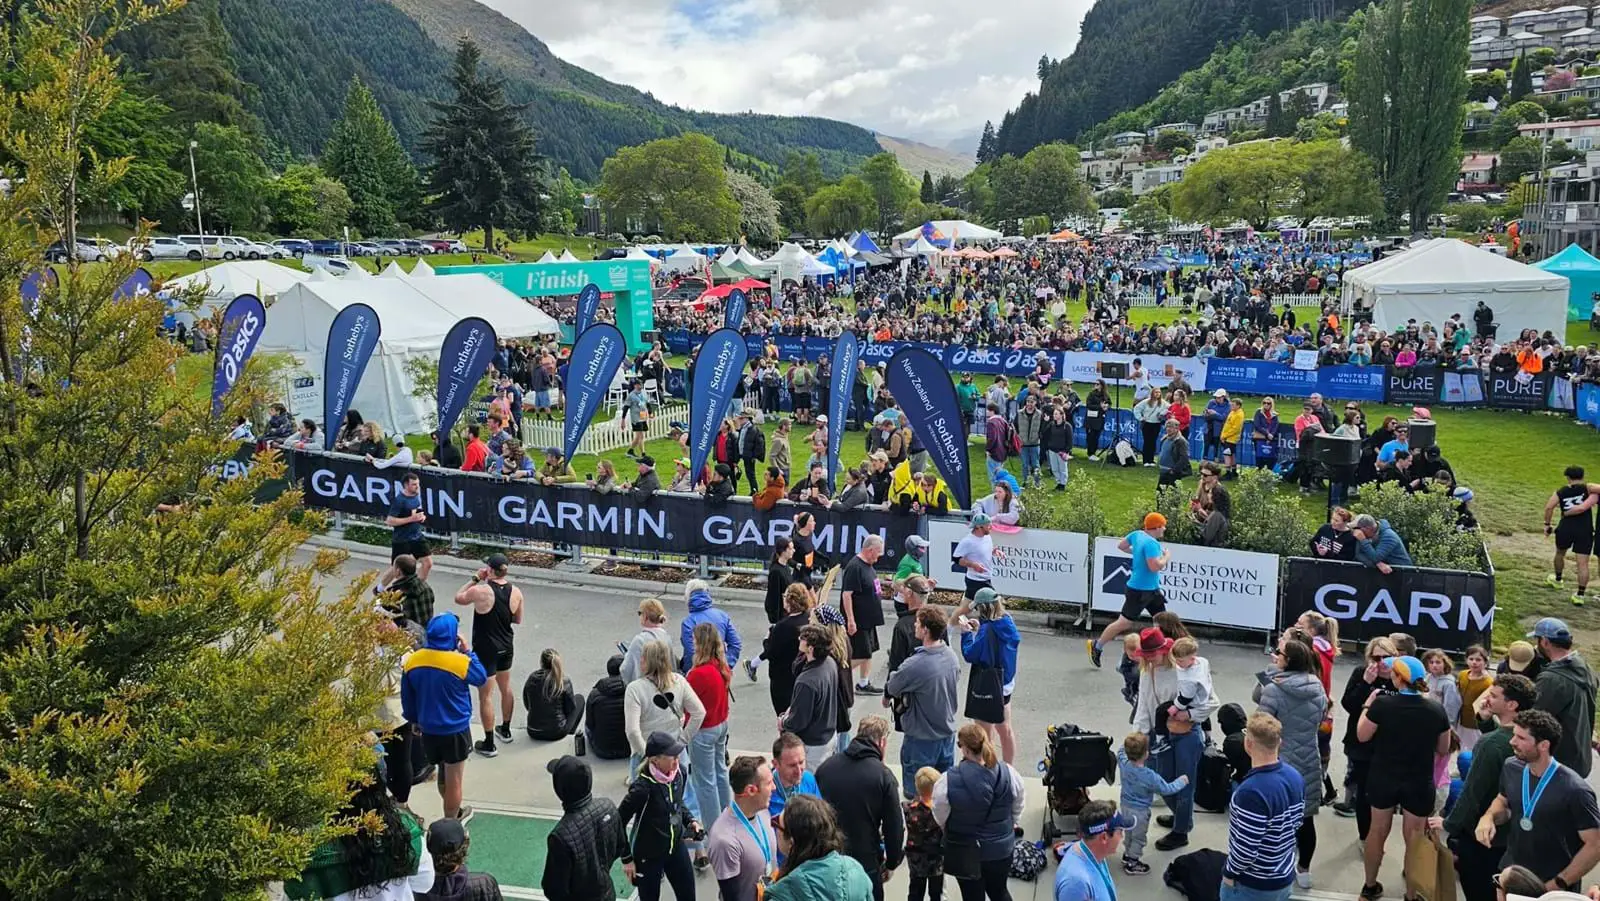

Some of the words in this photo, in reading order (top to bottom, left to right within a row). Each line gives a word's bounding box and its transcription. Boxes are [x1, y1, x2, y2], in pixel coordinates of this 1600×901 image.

[527, 269, 590, 290] Finish
[232, 311, 259, 360] asics
[344, 314, 365, 359] Sotheby's
[454, 327, 479, 374] Sotheby's
[584, 335, 608, 383] Sotheby's
[712, 339, 732, 389] Sotheby's
[866, 344, 894, 358] asics
[967, 349, 1001, 365] asics
[838, 342, 851, 392] Sotheby's
[336, 368, 350, 398] Zealand
[440, 382, 457, 413] Zealand
[900, 357, 915, 378] New
[911, 376, 934, 411] Zealand
[1391, 376, 1434, 390] PURE
[1494, 379, 1543, 395] PURE
[333, 398, 344, 415] New
[572, 392, 588, 423] Zealand
[702, 398, 717, 431] Zealand
[834, 402, 843, 434] Zealand
[568, 422, 579, 442] New
[698, 431, 708, 450] New
[933, 417, 962, 471] Sotheby's
[1563, 493, 1585, 509] 33
[498, 495, 665, 539] GARMIN
[992, 568, 1039, 581] OUNCIL
[1019, 559, 1075, 573] DISTRICT
[1160, 589, 1217, 605] OUNCIL
[1193, 578, 1266, 596] DISTRICT
